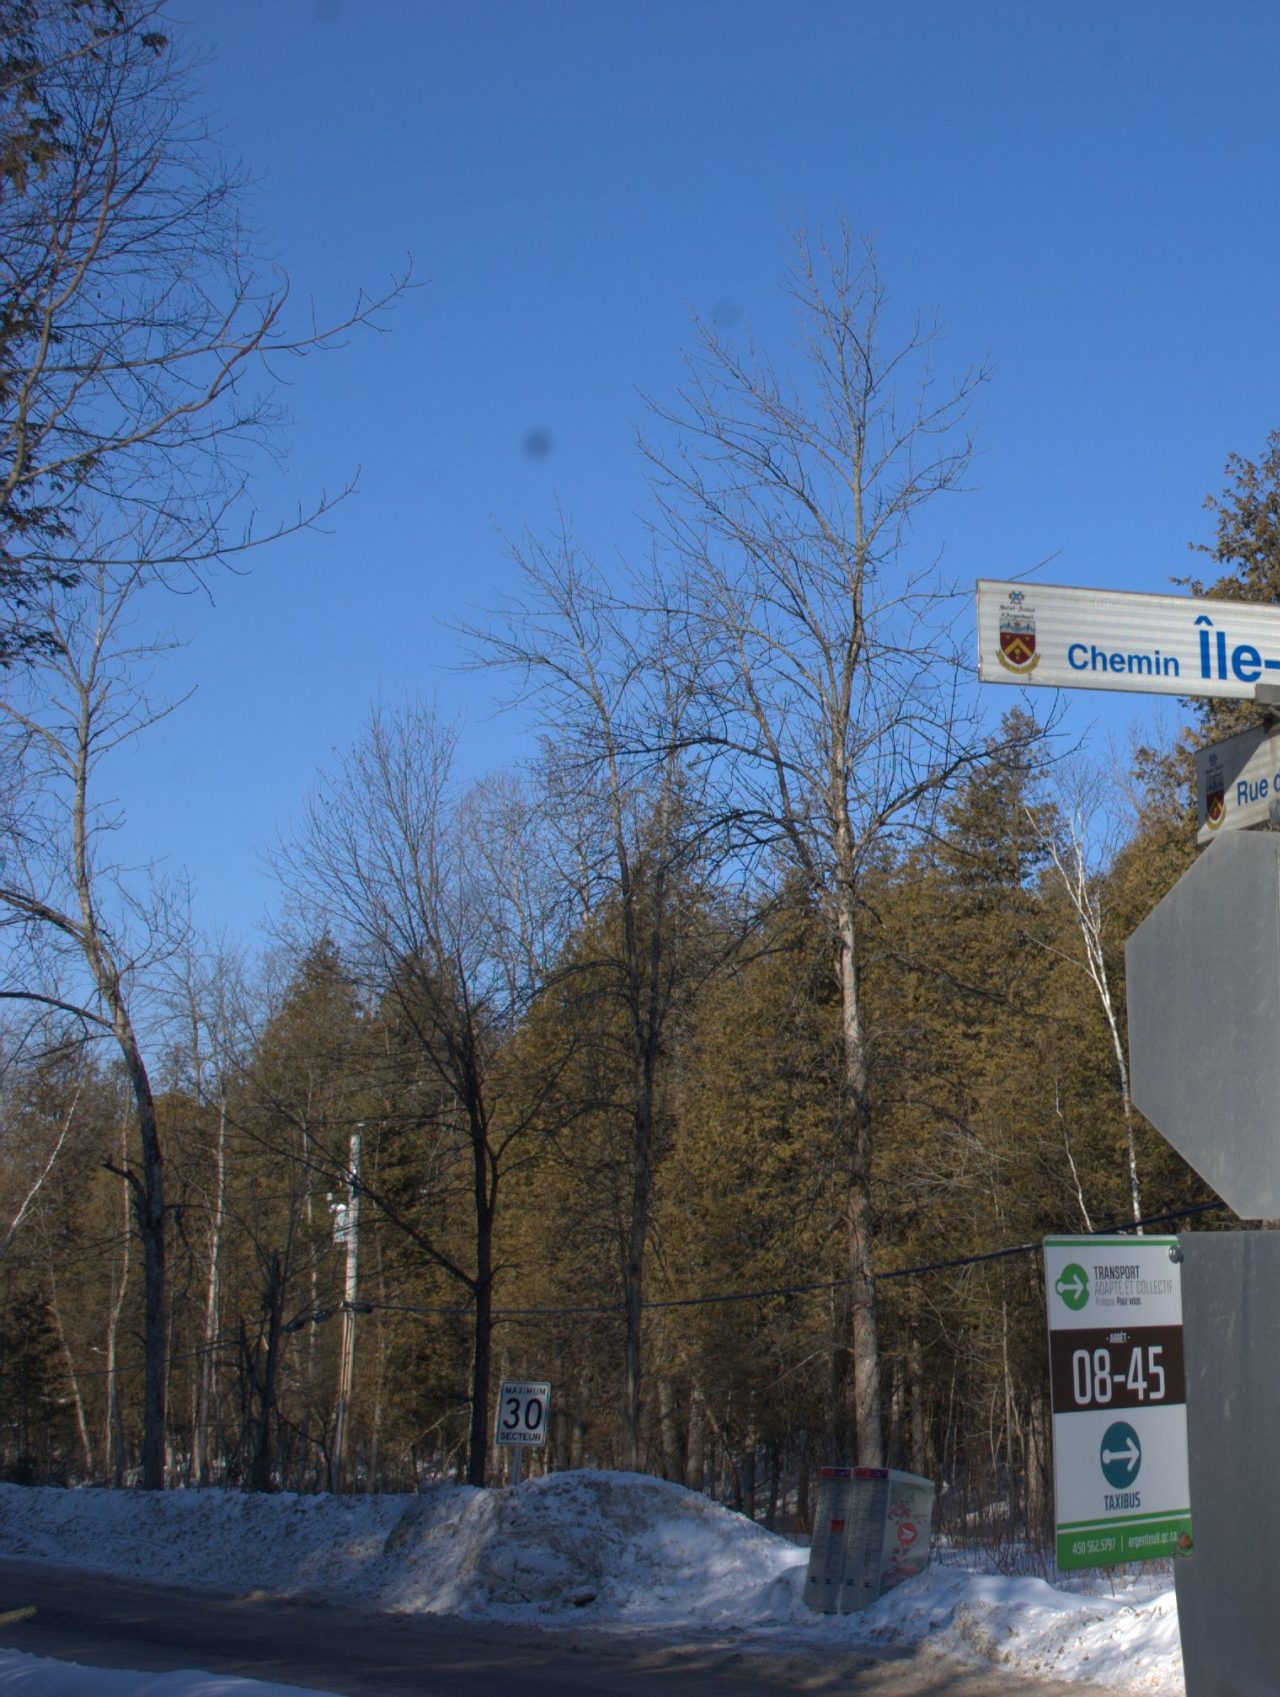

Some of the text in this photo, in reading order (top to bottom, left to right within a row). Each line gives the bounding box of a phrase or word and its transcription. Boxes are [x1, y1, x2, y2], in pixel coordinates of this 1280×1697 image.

[1067, 643, 1180, 677] Chemin
[1236, 776, 1269, 807] Rue
[1094, 1265, 1140, 1280] TRANSPORT
[1125, 1280, 1134, 1295] ET
[1136, 1279, 1173, 1295] COLLECTIF
[1116, 1296, 1128, 1306] Pour
[1072, 1345, 1166, 1405] 08-45
[505, 1386, 546, 1396] MAXIMUM
[503, 1397, 543, 1431] 30
[500, 1432, 541, 1441] SECTEUR
[1104, 1491, 1141, 1511] TAXIBUS
